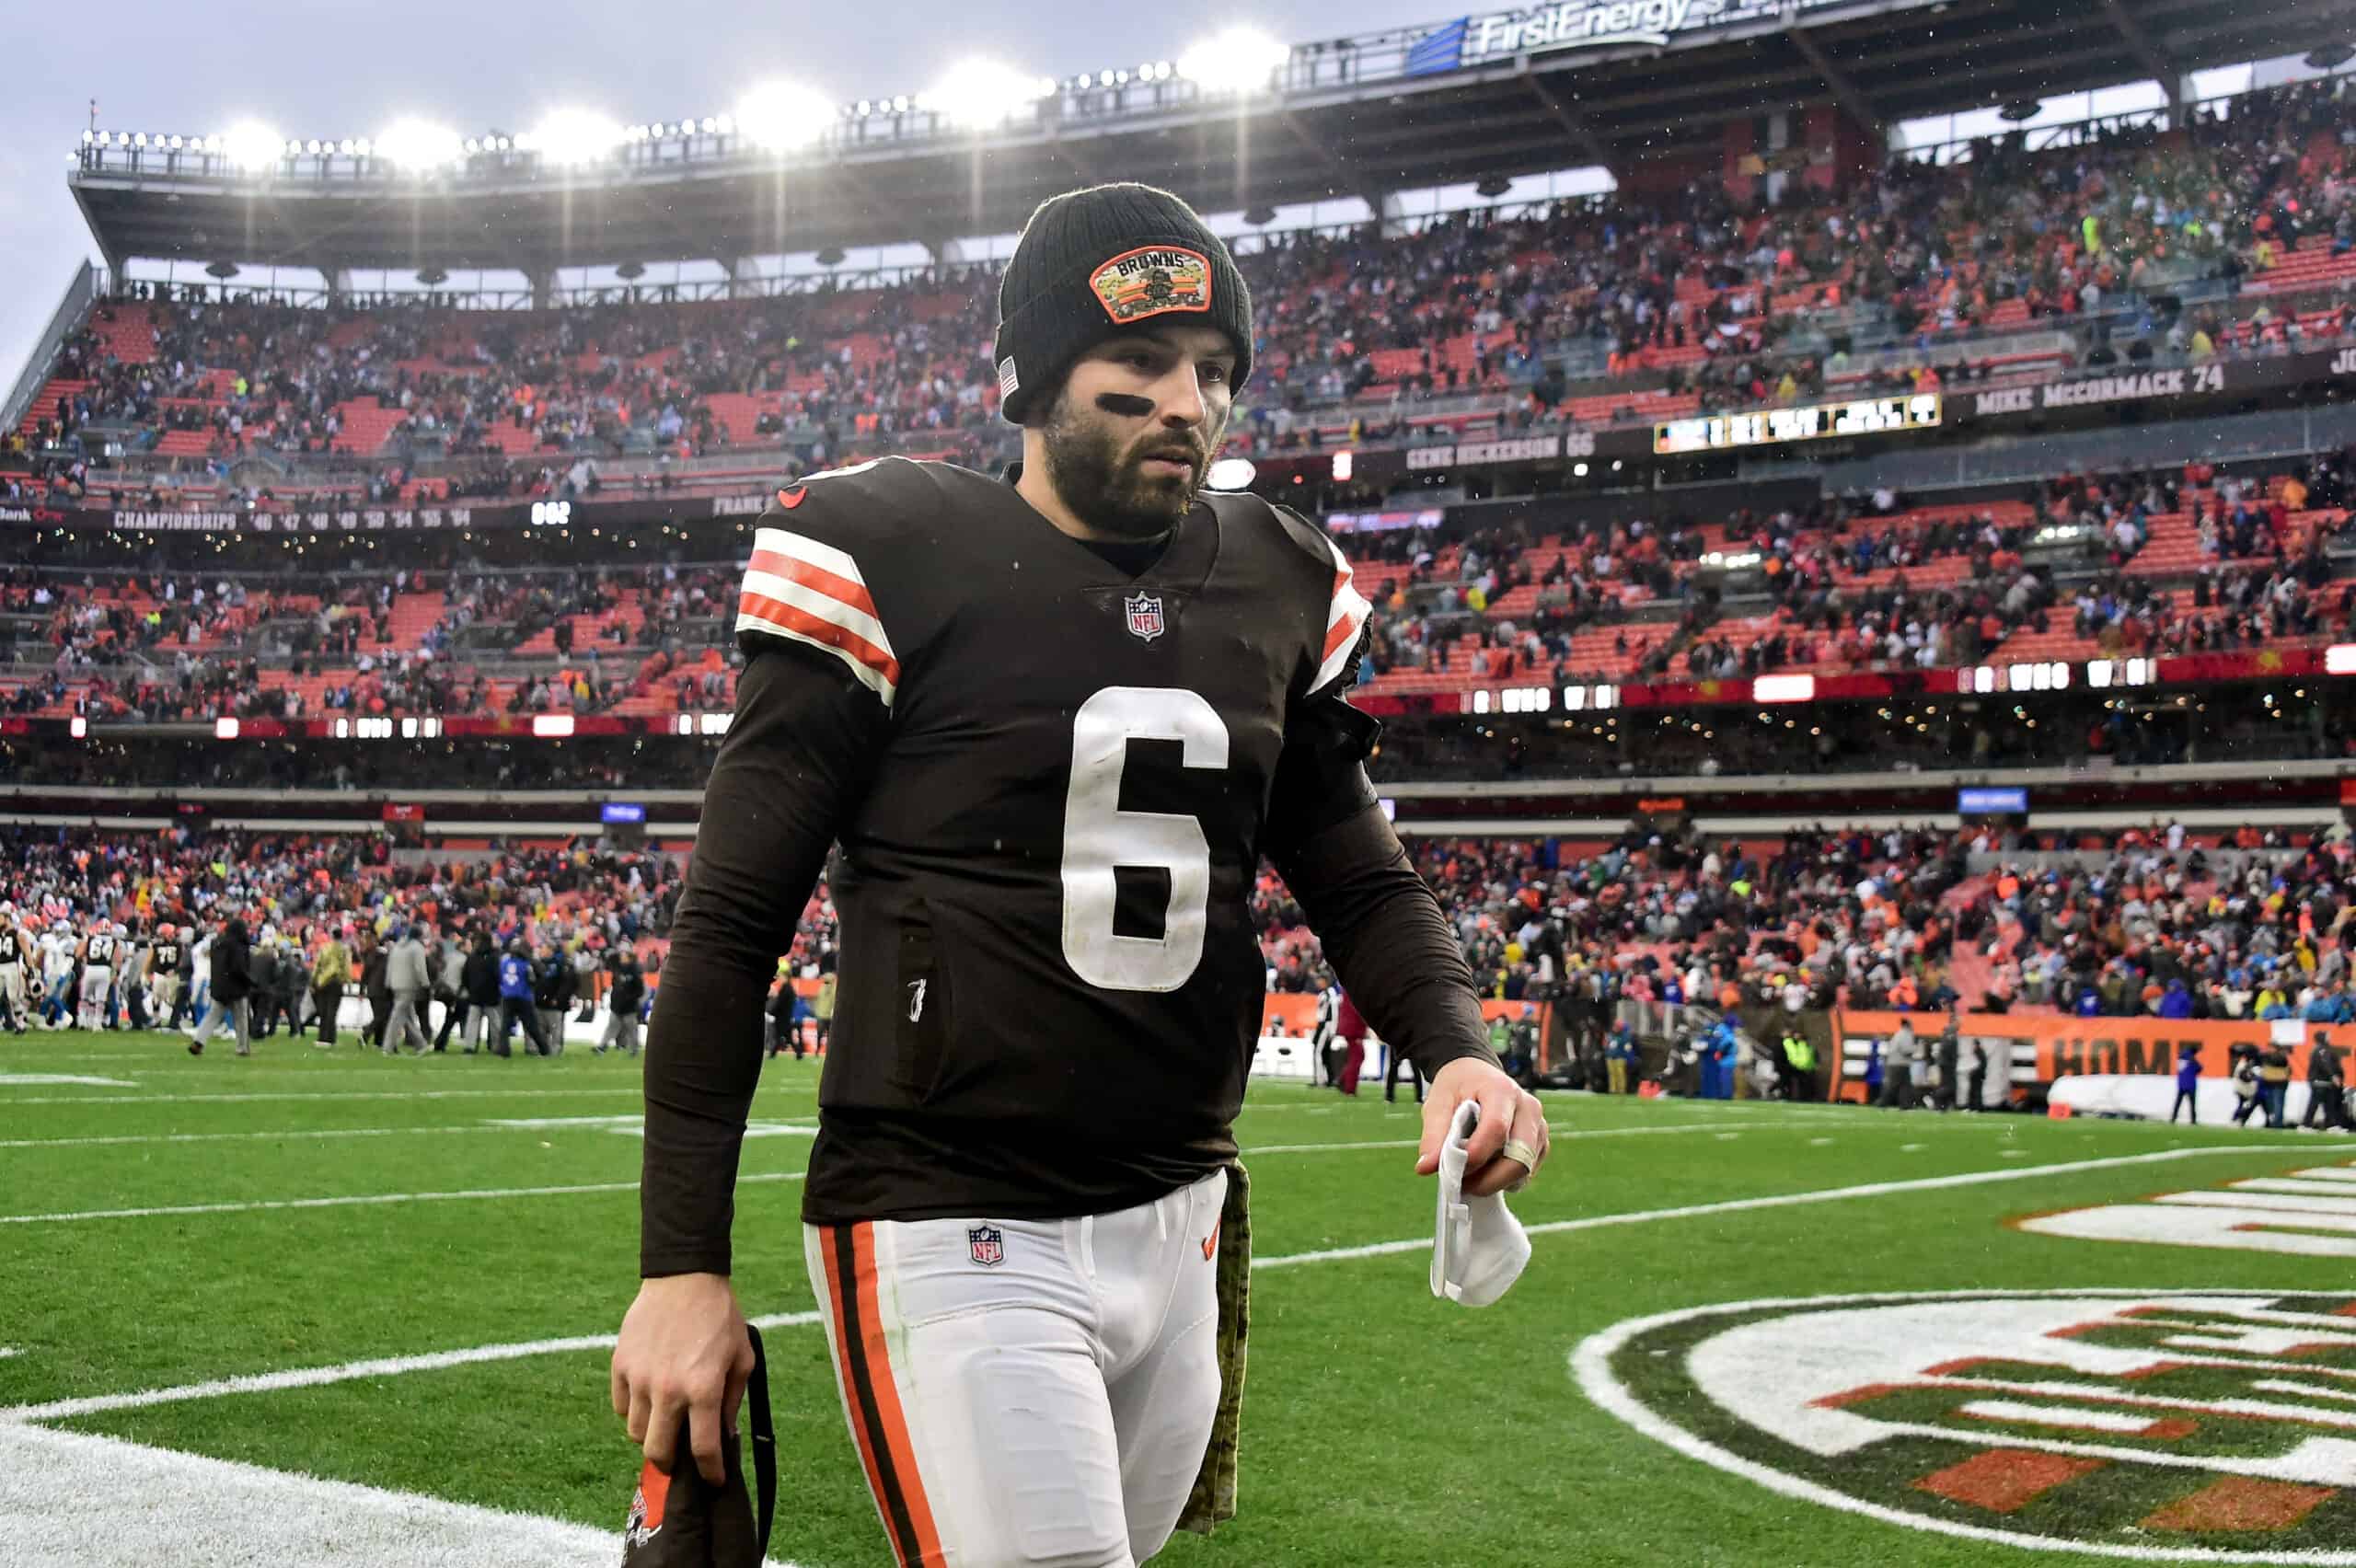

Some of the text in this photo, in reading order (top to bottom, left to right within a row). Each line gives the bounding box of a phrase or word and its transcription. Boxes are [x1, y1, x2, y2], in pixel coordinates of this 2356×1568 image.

[1480, 0, 1690, 53] FirstEnergy
[1117, 251, 1184, 276] BROWNS
[1976, 386, 2032, 415] MIKE
[2192, 364, 2224, 392] 74
[114, 512, 237, 530] CHAMPIONSHIPS
[1132, 613, 1160, 633] NFL
[1061, 686, 1230, 993] 6
[973, 1242, 1001, 1262] NFL
